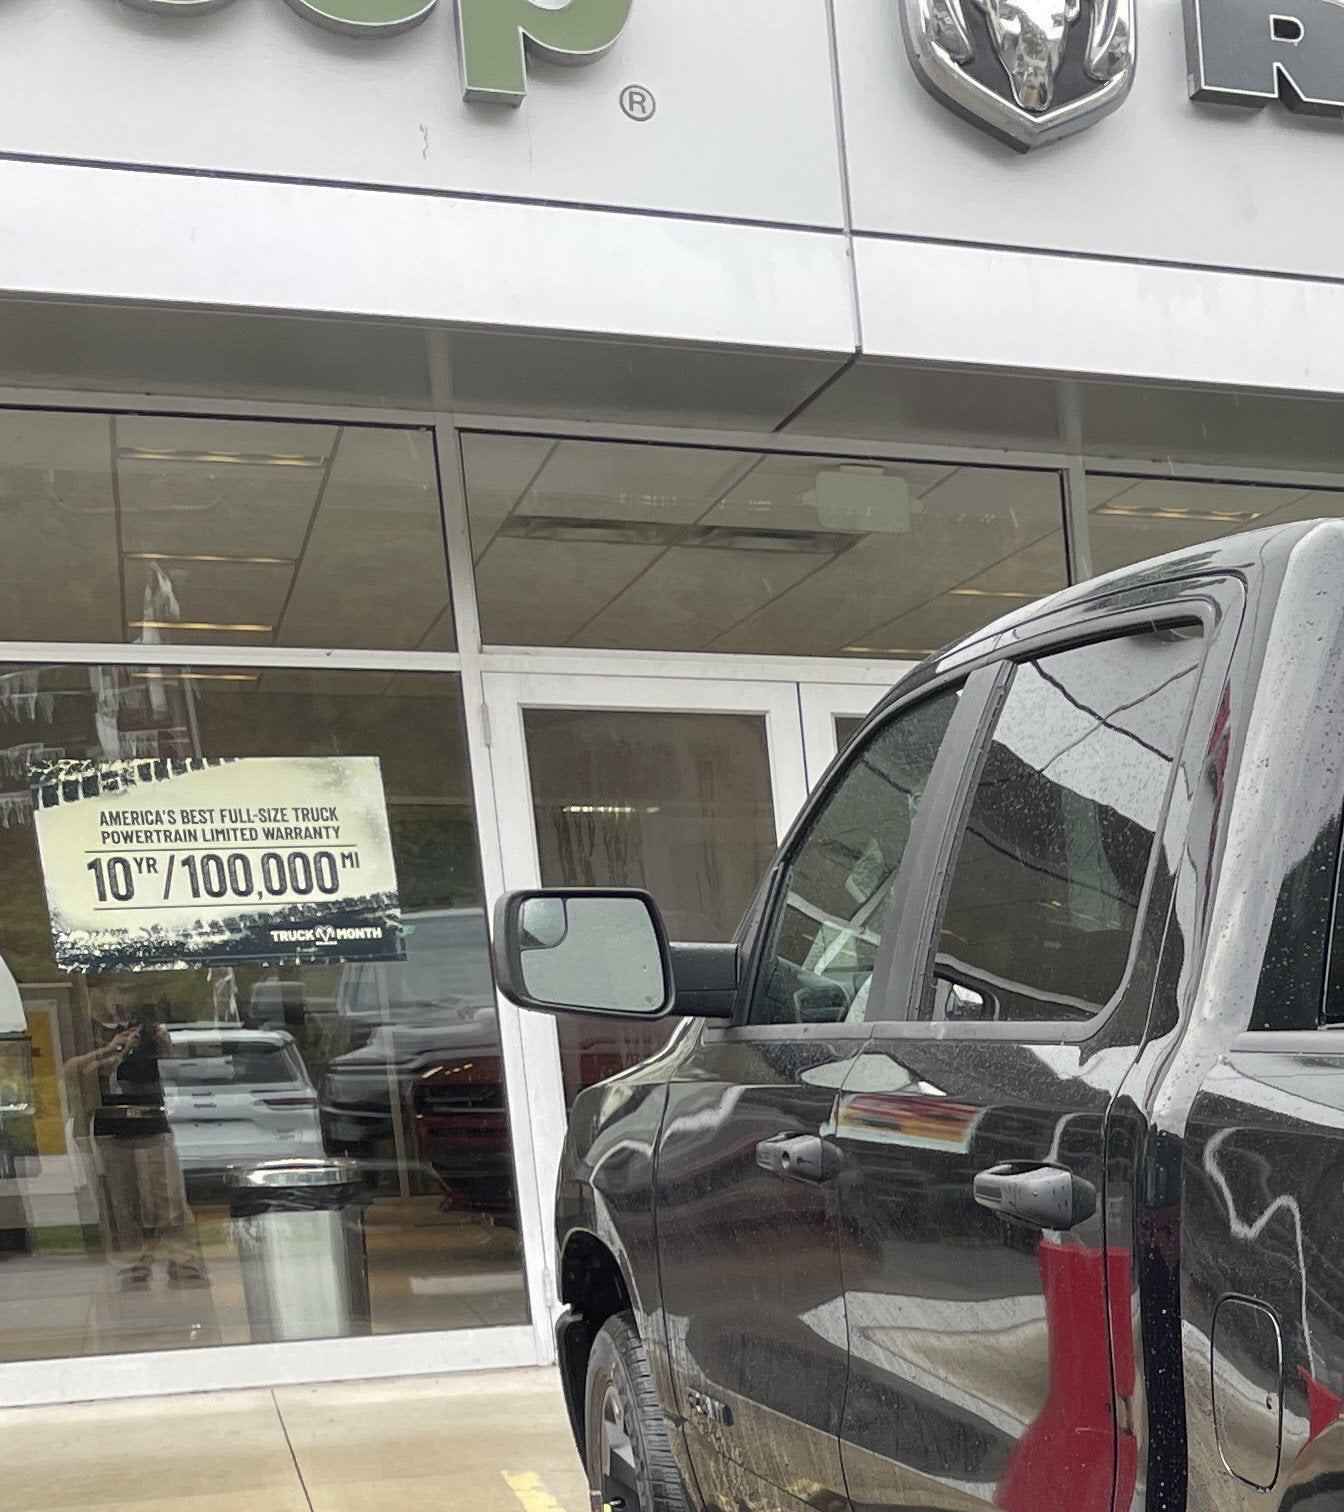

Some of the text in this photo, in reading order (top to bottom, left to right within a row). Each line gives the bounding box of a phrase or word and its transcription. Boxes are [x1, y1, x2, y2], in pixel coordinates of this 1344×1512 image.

[99, 806, 339, 827] AMERICA'S BEST FULL-SIZE TRUCK
[101, 826, 341, 845] POWERTRAIN LIMITED WARRANTY
[269, 927, 383, 942] TRUCK MONTH
